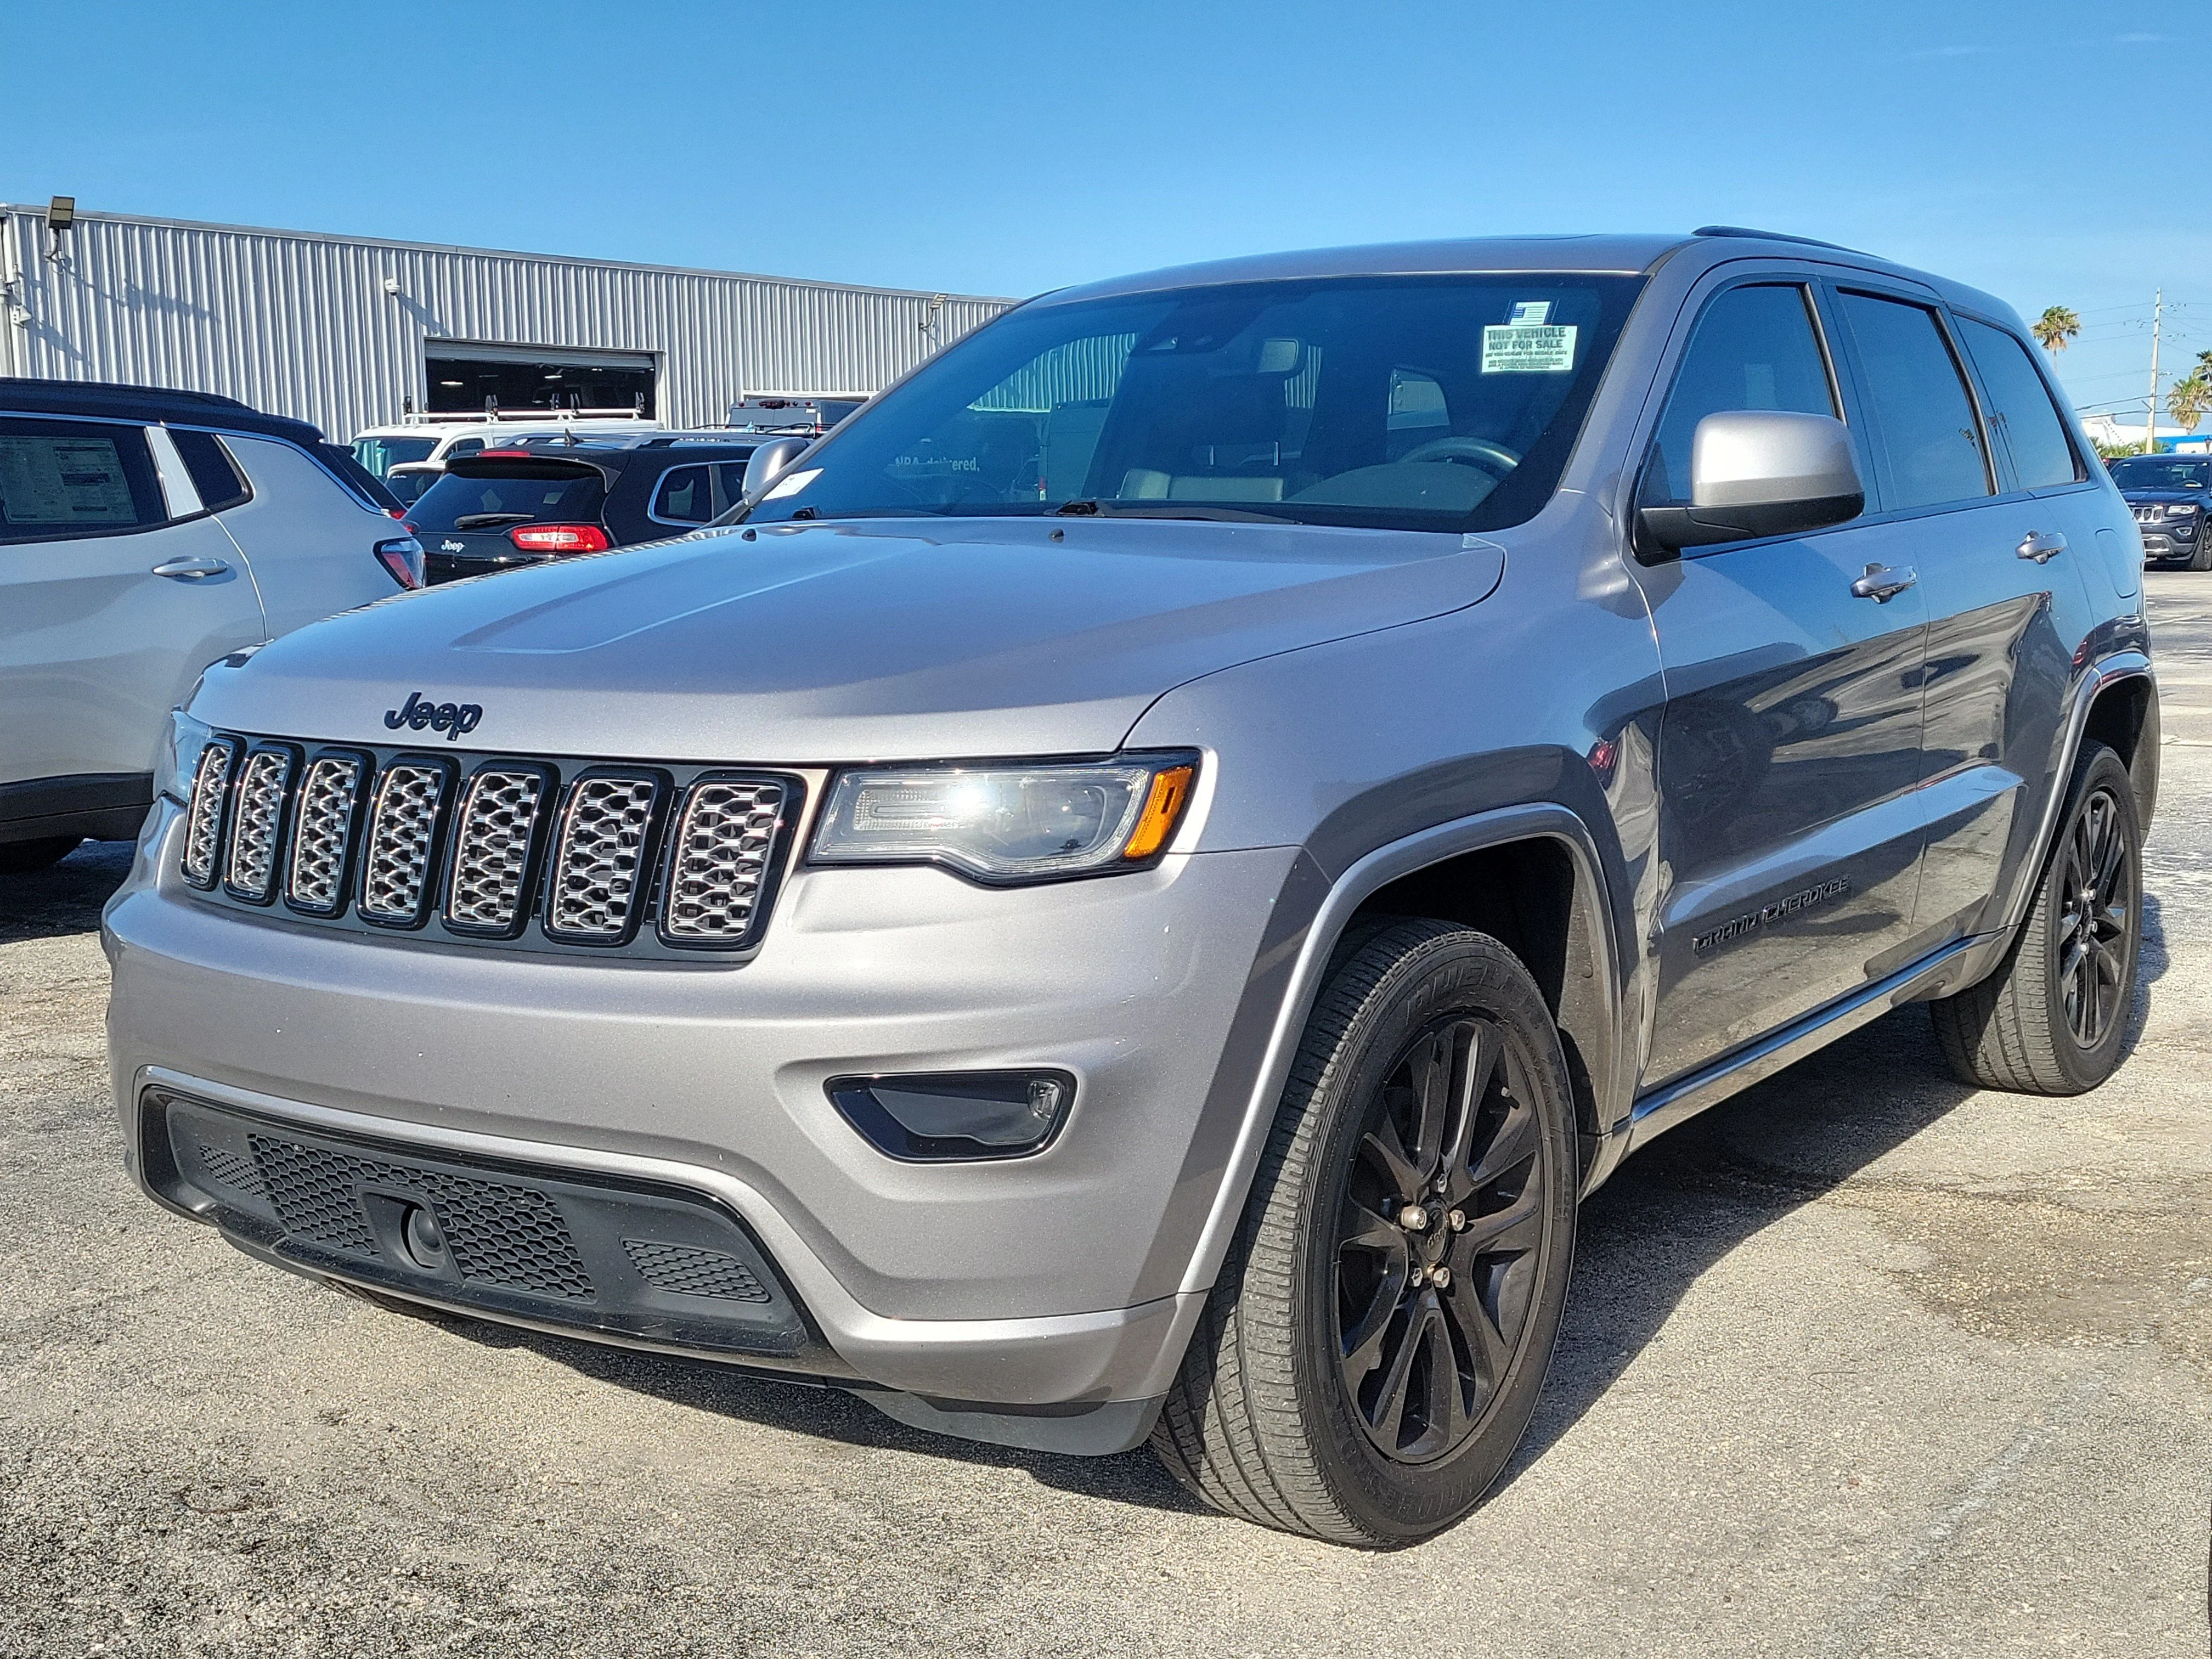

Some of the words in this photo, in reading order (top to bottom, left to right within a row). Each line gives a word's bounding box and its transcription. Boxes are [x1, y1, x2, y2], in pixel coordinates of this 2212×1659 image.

[1487, 330, 1513, 340] THIS
[1516, 327, 1566, 338] VEHICLE
[1489, 341, 1509, 350] NOT
[1512, 340, 1532, 349] FOR
[1536, 339, 1563, 348] SALE
[441, 539, 465, 553] Jeep
[383, 691, 483, 742] Jeep
[1692, 911, 1759, 953] GRAND
[1762, 876, 1849, 923] CHEROKEE
